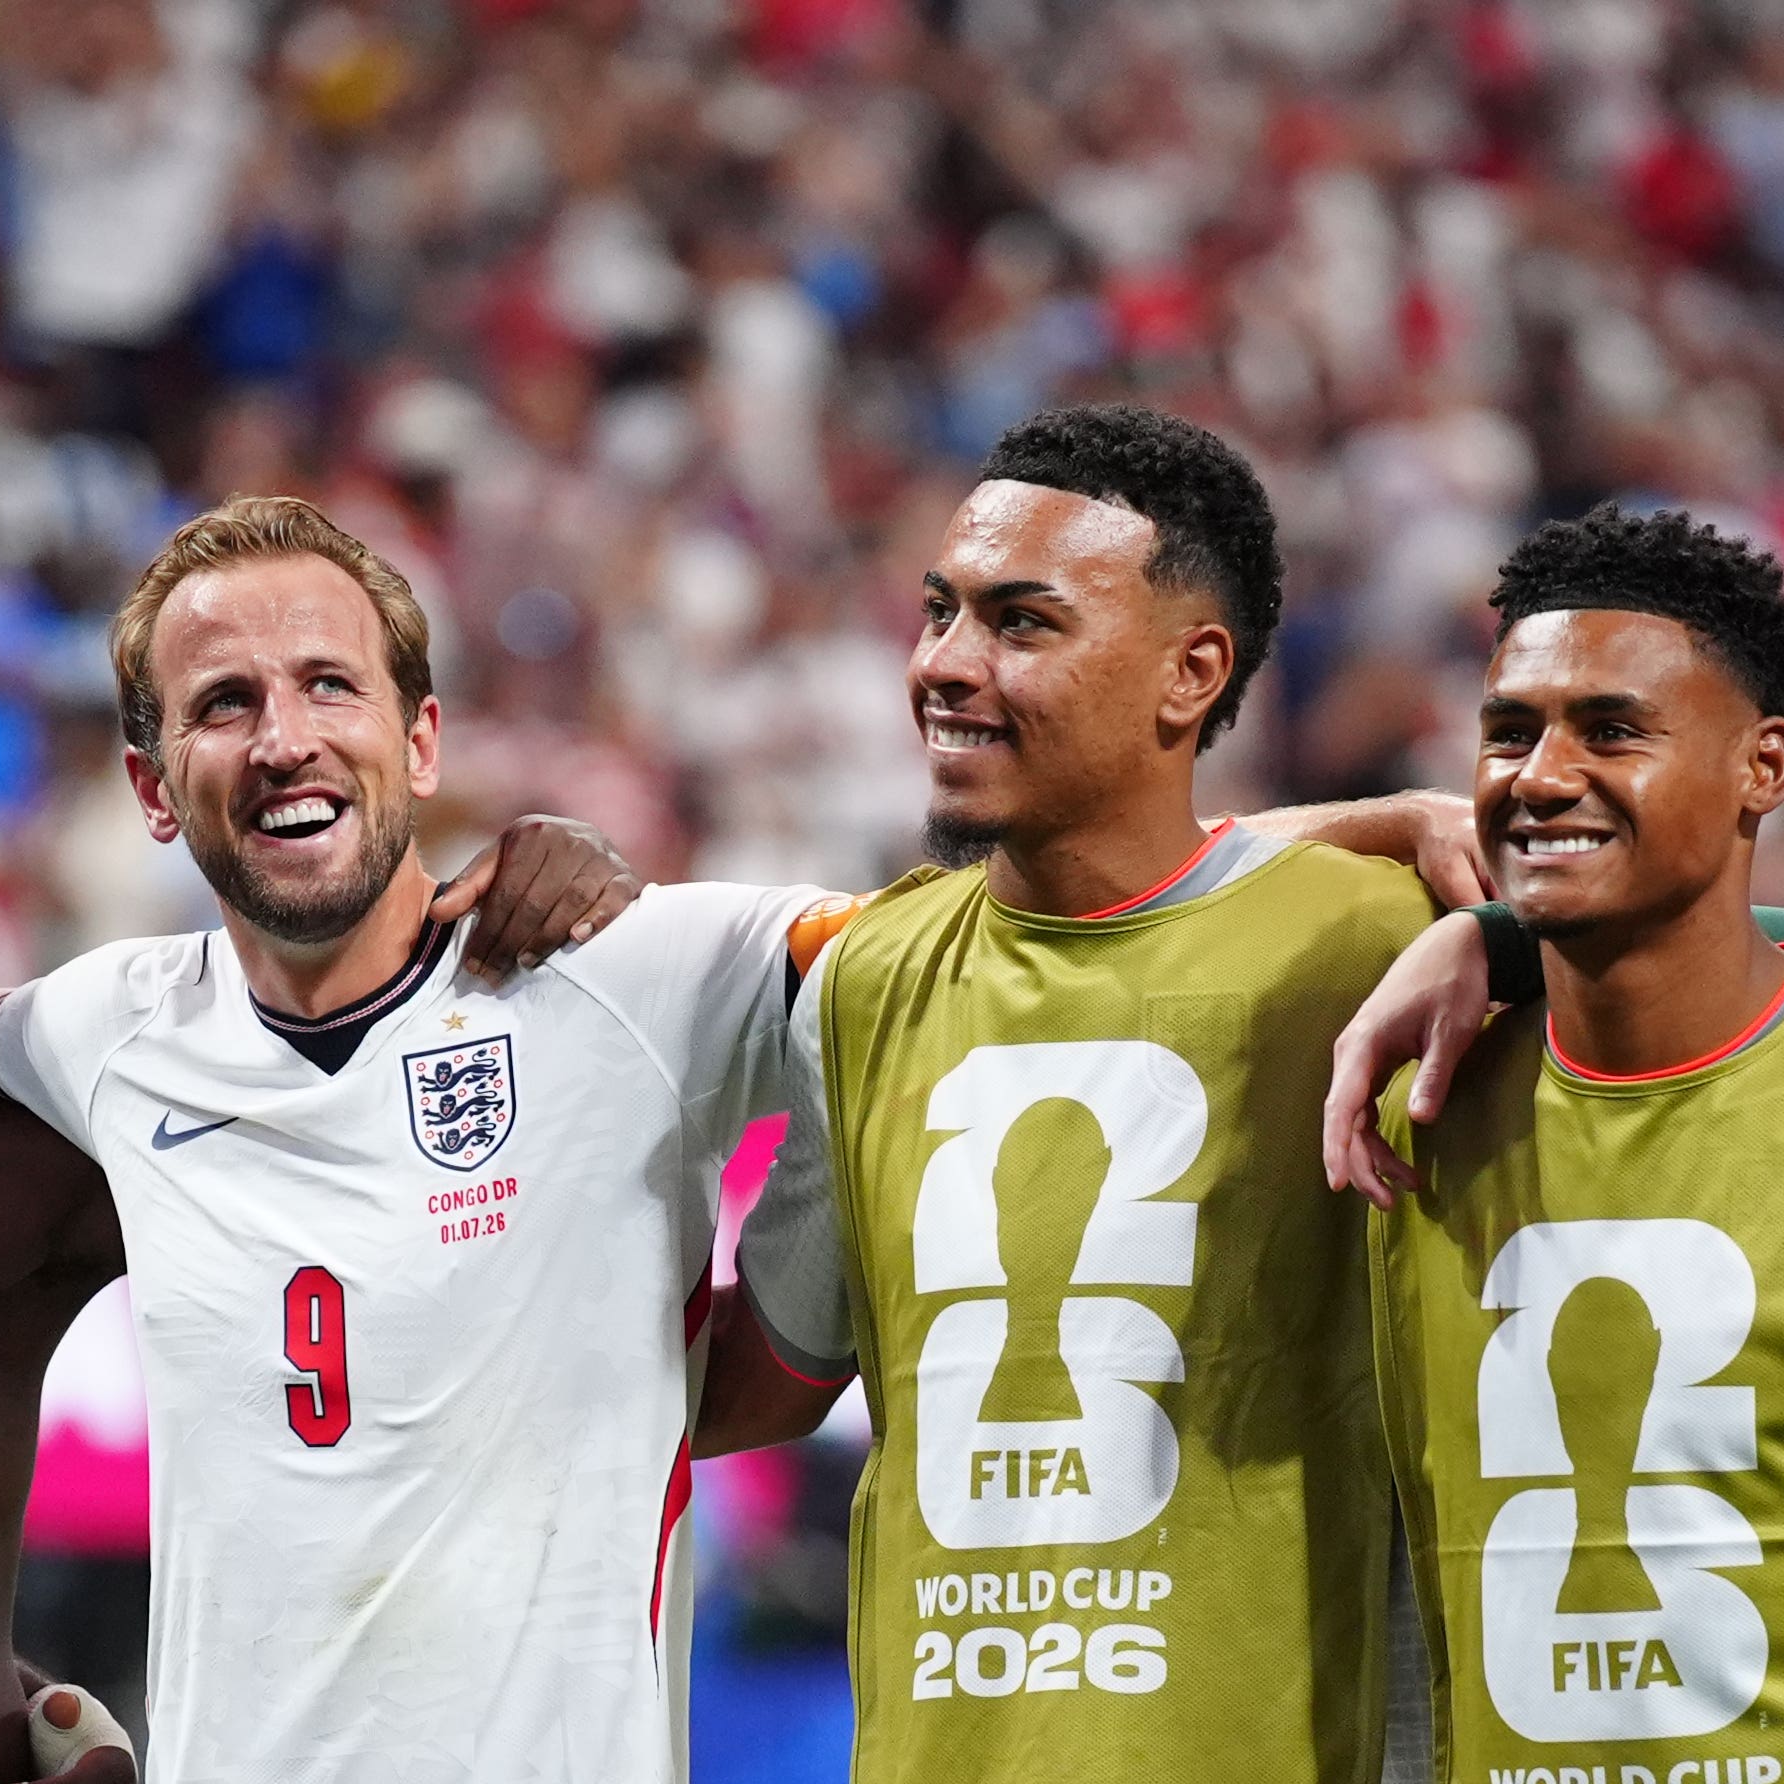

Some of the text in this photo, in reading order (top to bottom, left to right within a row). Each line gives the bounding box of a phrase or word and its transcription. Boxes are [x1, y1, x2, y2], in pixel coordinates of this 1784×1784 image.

[428, 1177, 518, 1215] CONGO DR
[440, 1211, 507, 1244] 01.07.26
[283, 1265, 352, 1448] 9
[969, 1447, 1091, 1500] FIFA
[915, 1566, 1173, 1619] WORLD CUP
[912, 1622, 1168, 1701] 2026
[1551, 1638, 1684, 1693] FIFA
